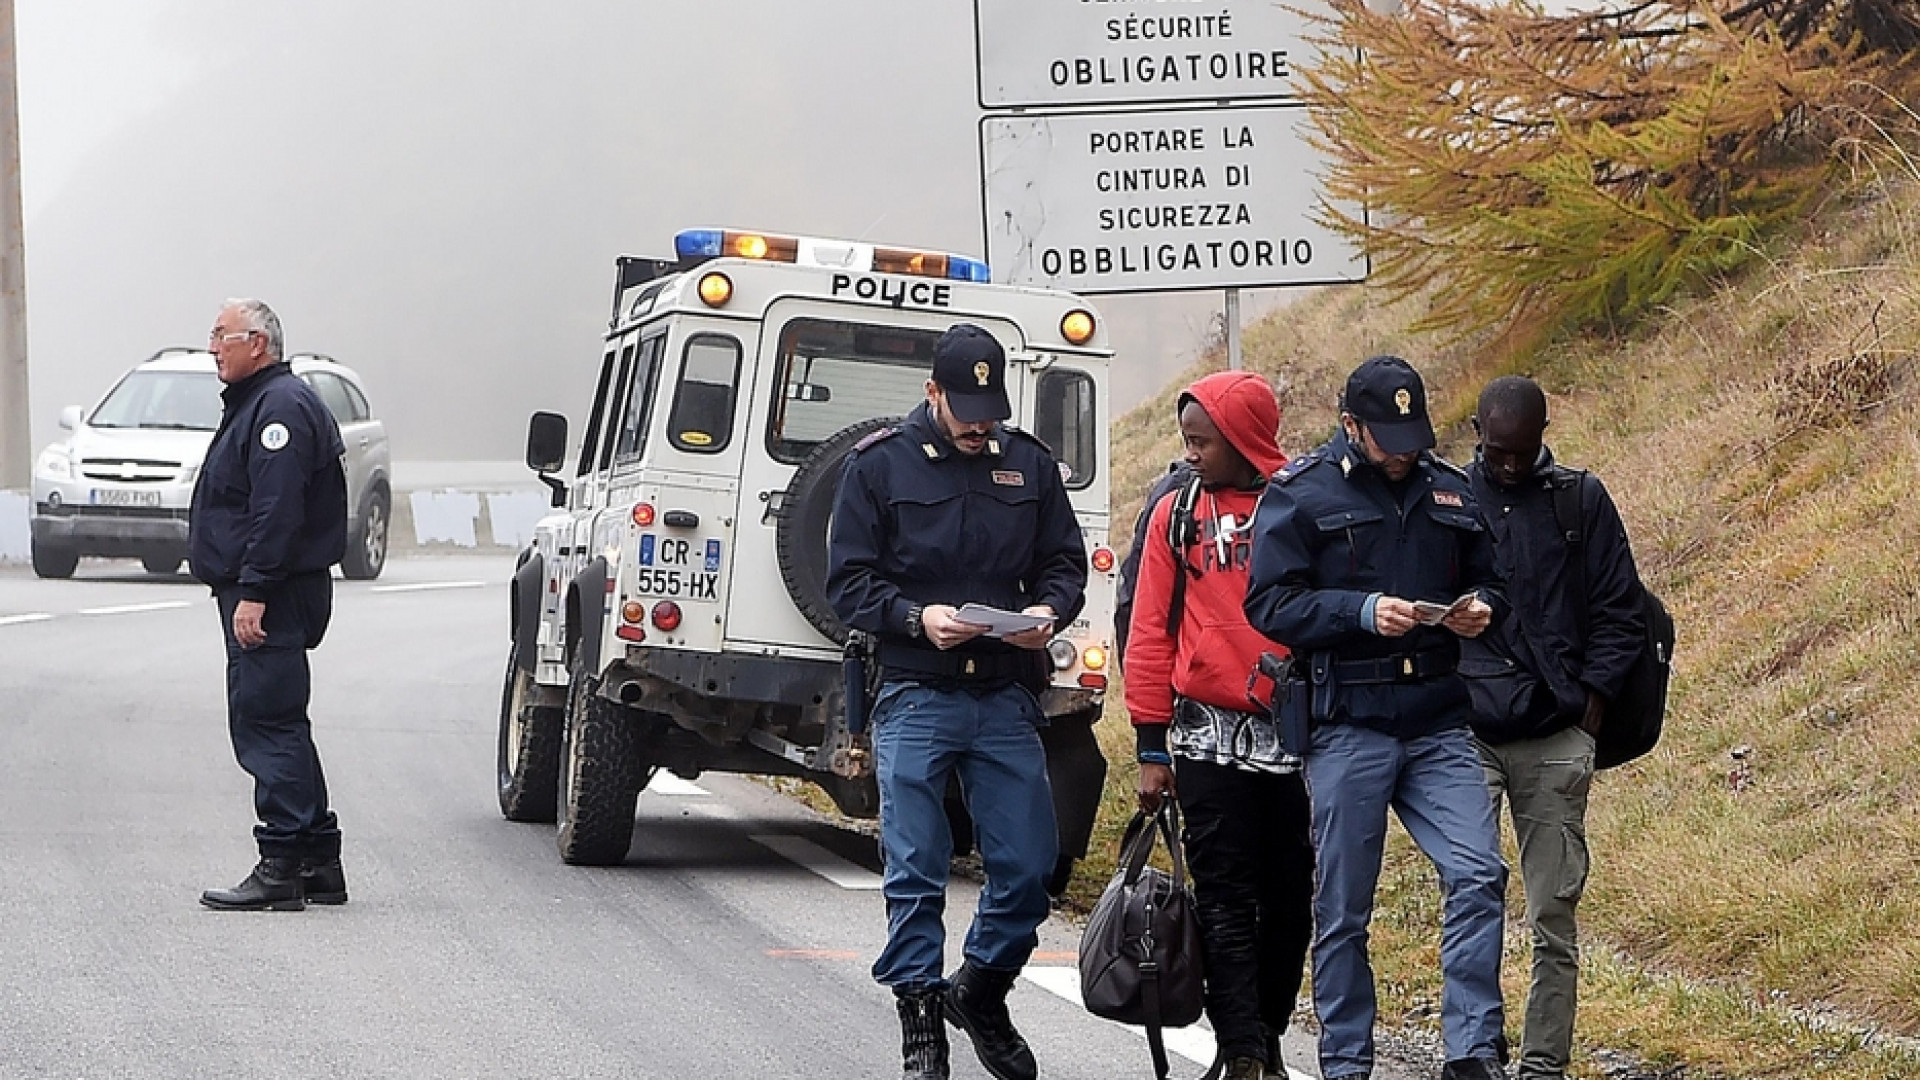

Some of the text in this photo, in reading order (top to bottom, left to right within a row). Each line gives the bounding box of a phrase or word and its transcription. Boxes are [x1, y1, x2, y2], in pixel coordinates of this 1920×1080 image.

[1107, 9, 1232, 40] SÉCURITÉ
[1050, 50, 1290, 86] OBLIGATOIRE
[1090, 126, 1255, 154] PORTARE LA
[1097, 165, 1249, 192] CINTURA DI
[1099, 203, 1251, 231] SICUREZZA
[1041, 239, 1312, 277] OBBLIGATORIO
[831, 273, 951, 307] POLICE
[638, 568, 718, 599] 555-HX
